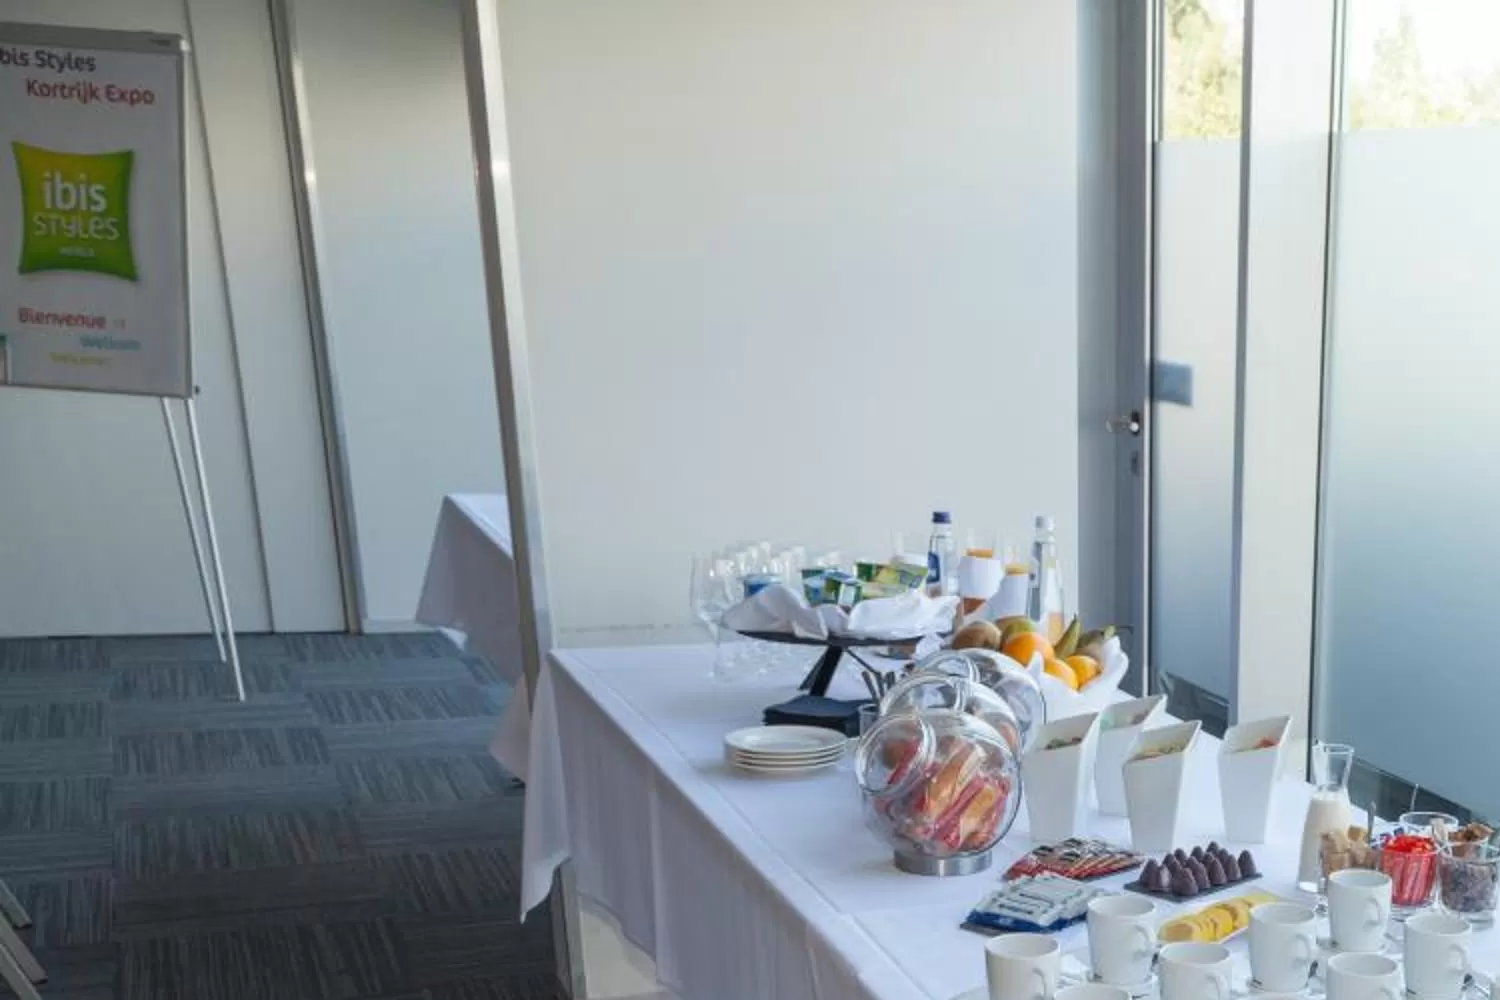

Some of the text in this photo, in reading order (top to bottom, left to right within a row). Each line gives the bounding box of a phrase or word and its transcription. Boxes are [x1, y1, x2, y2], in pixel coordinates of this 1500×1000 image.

[35, 49, 97, 73] Styles
[26, 79, 156, 107] Kortrijk Expo
[43, 170, 107, 212] ibis
[18, 306, 106, 329] Bienvenue
